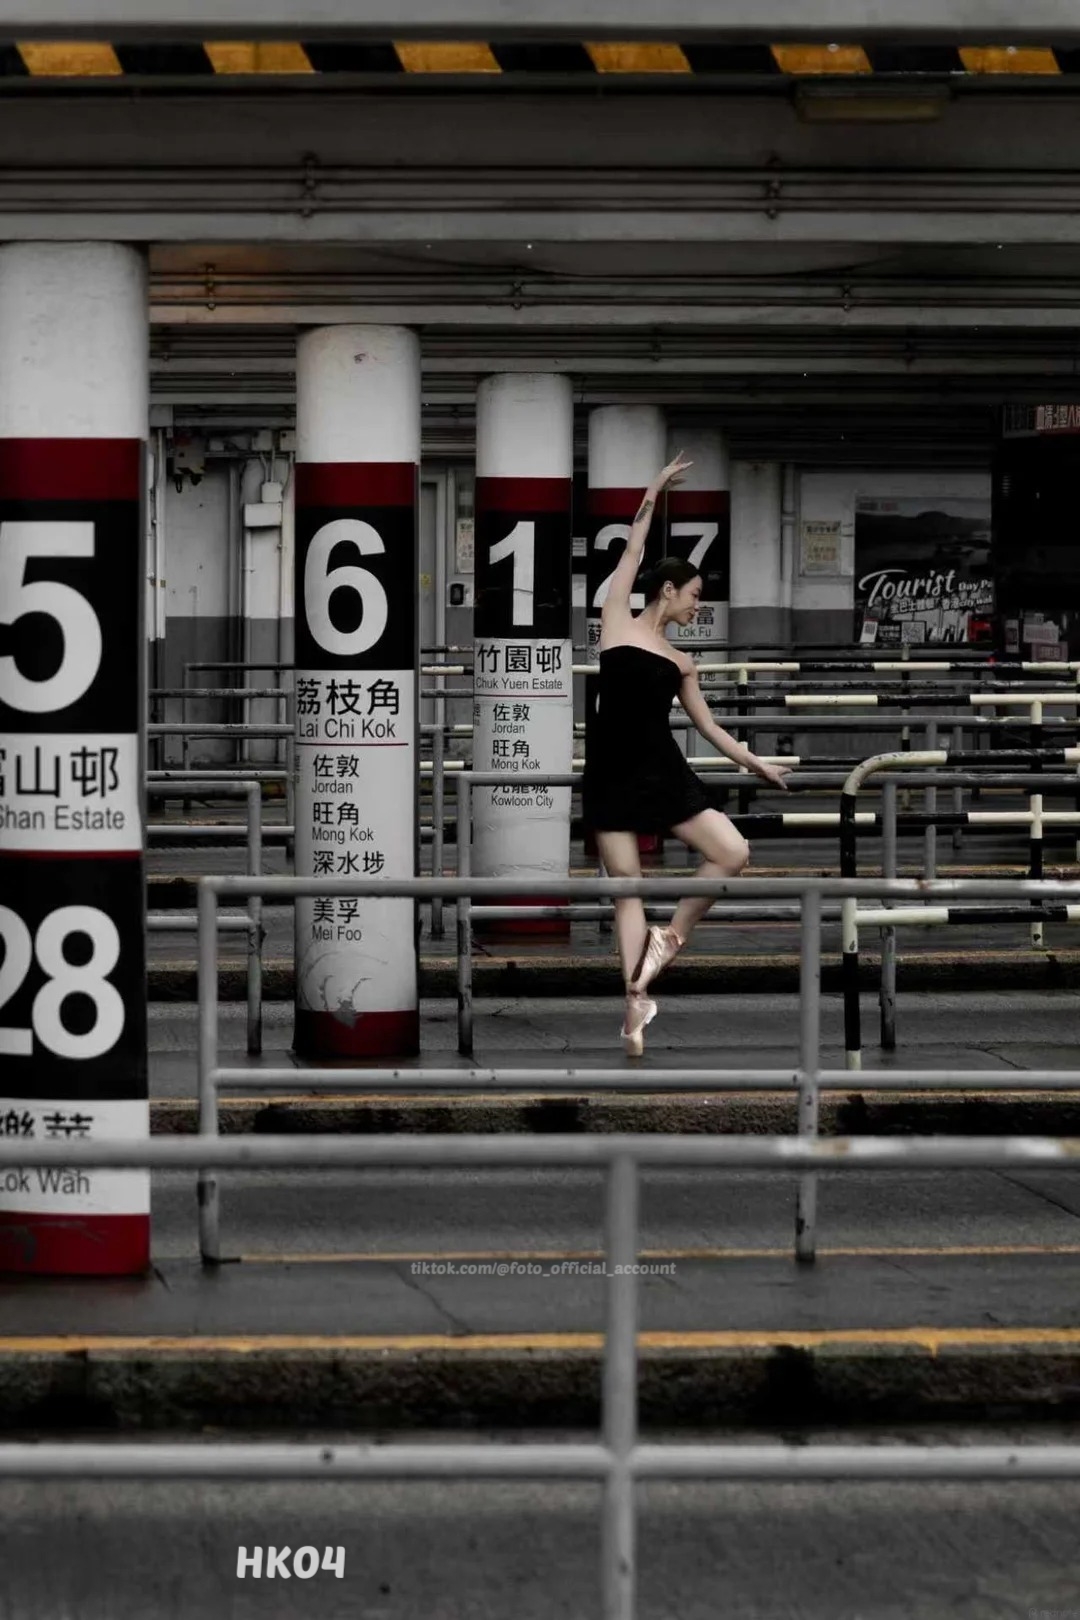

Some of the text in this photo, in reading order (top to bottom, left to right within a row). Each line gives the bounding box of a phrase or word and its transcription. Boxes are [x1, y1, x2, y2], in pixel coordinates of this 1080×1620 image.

[670, 522, 718, 569] 7
[489, 521, 537, 627] 1
[593, 523, 645, 609] 2
[305, 519, 388, 655] 6
[858, 568, 956, 607] Tourist
[958, 581, 979, 591] Day
[0, 521, 102, 713] 5
[690, 606, 715, 626] 富
[678, 626, 712, 638] Lok Fu
[477, 644, 561, 674] 竹園邨
[475, 677, 563, 690] Chuk Yuen Estate
[296, 678, 399, 716] 荔枝角
[493, 703, 530, 721] 佐敦
[299, 718, 395, 738] Lai Chi Kok
[491, 722, 525, 735] Jordan
[492, 740, 529, 759] 旺角
[0, 746, 118, 798] 山邨
[313, 754, 359, 780] 佐敦
[490, 757, 540, 772] Mong Kok
[311, 779, 352, 795] Jordan
[490, 794, 553, 808] Kowloon City
[54, 805, 125, 830] Estate
[312, 802, 358, 827] 旺角
[310, 825, 374, 846] Mong Kok
[311, 850, 384, 876] 深水埗
[311, 897, 360, 925] 美孚
[310, 924, 361, 943] Mei Foo
[0, 1166, 92, 1193] ok Wah
